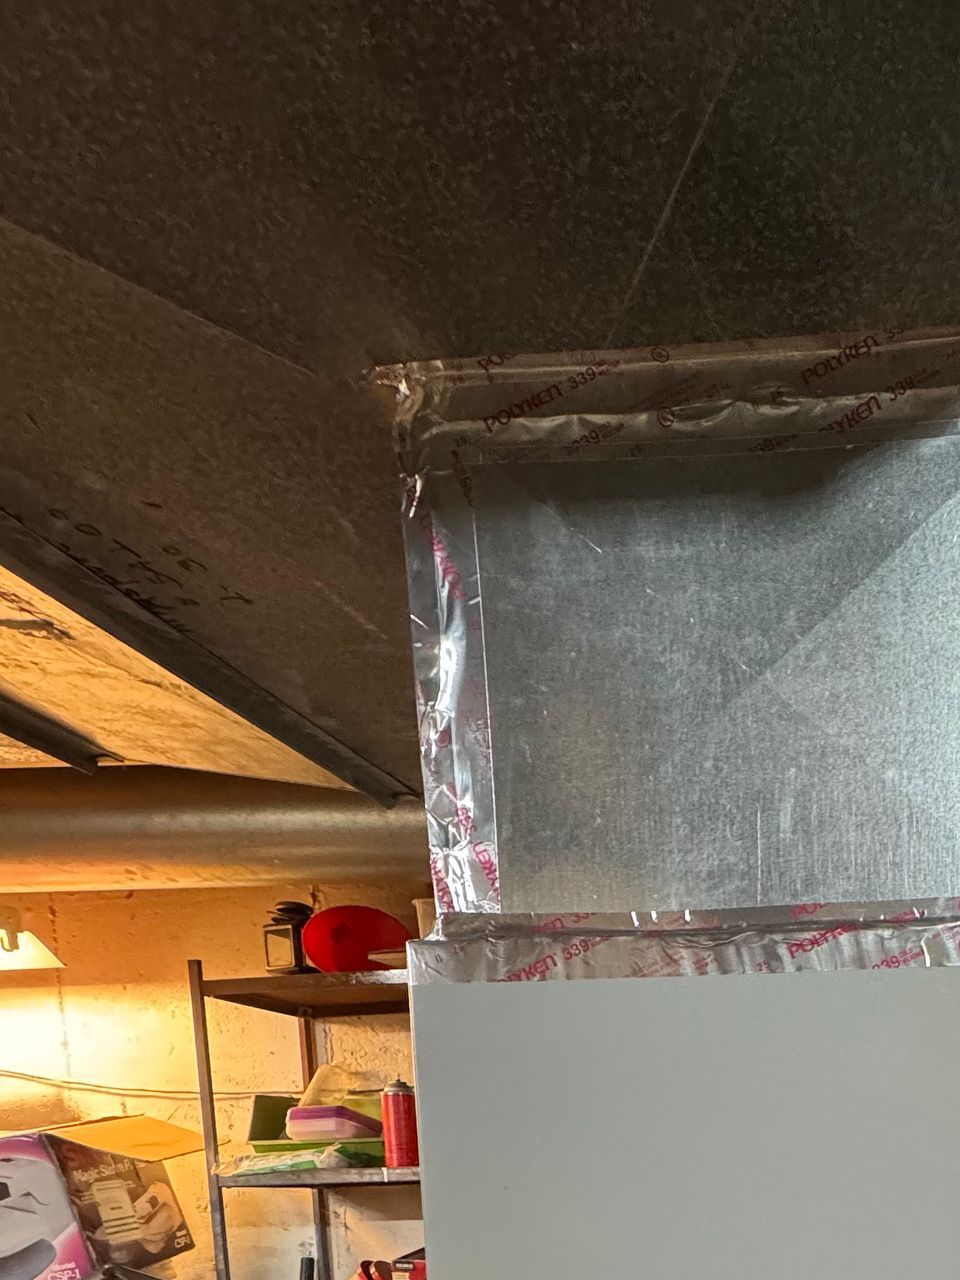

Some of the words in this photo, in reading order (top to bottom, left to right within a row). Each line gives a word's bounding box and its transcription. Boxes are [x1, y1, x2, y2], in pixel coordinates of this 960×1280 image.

[801, 335, 881, 385] POLYKEN
[482, 384, 564, 433] POLYKEN
[567, 365, 597, 391] 339
[562, 938, 590, 962] 339
[73, 1168, 99, 1183] Magic
